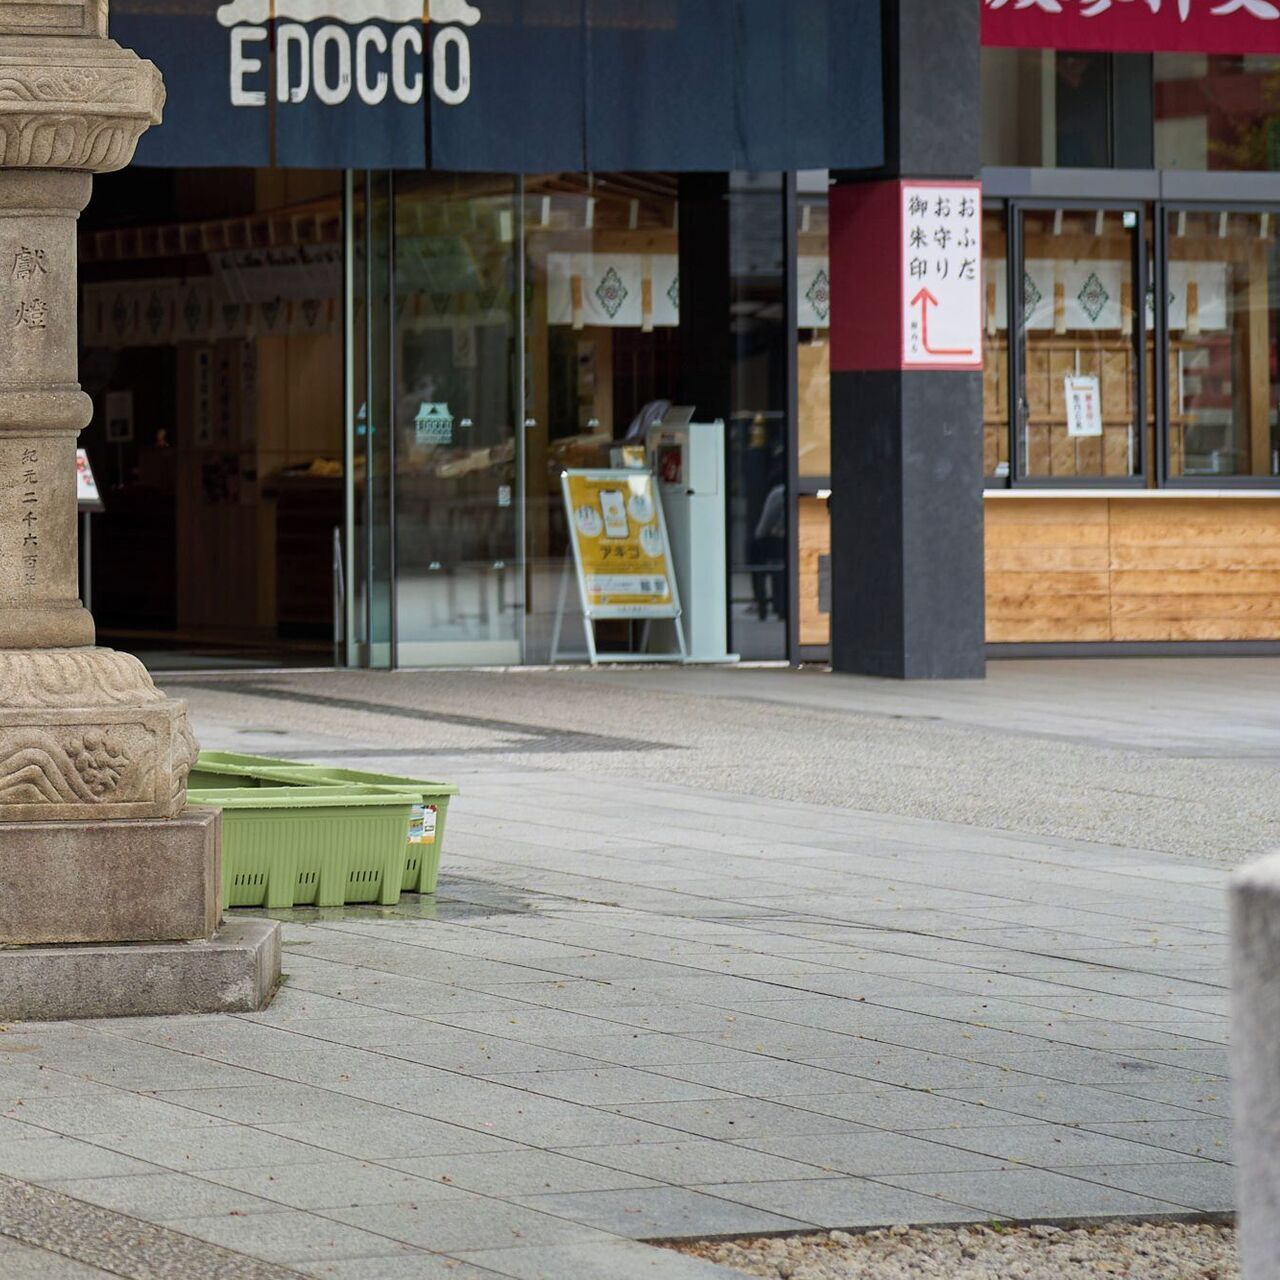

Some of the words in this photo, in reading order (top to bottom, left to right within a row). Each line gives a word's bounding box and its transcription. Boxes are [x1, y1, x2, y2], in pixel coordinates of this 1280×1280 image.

[230, 23, 471, 106] EDOCCO
[908, 195, 929, 280] 御朱印
[933, 195, 953, 280] お守り
[957, 195, 977, 280] おふだ
